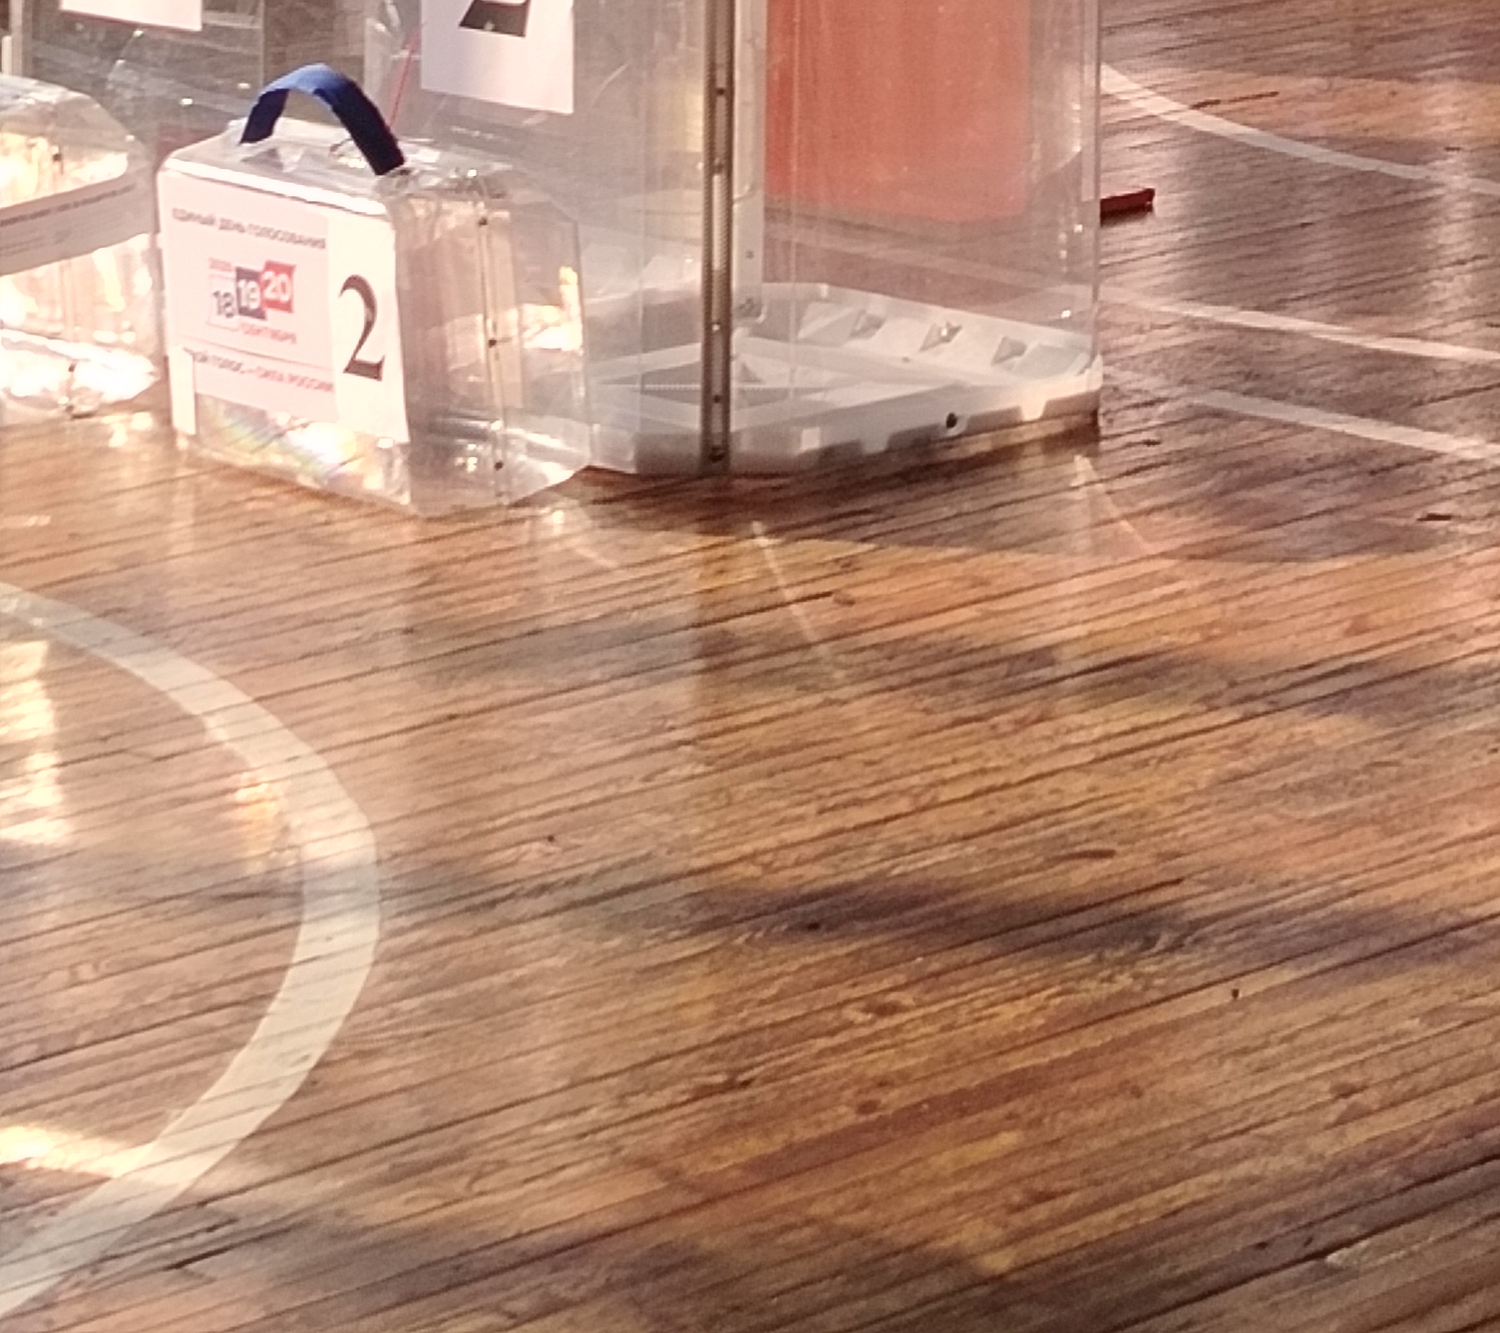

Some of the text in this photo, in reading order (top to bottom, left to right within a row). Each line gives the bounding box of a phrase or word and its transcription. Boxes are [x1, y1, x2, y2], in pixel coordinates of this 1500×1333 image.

[213, 271, 291, 319] 18 19 20
[338, 274, 385, 382] 2
